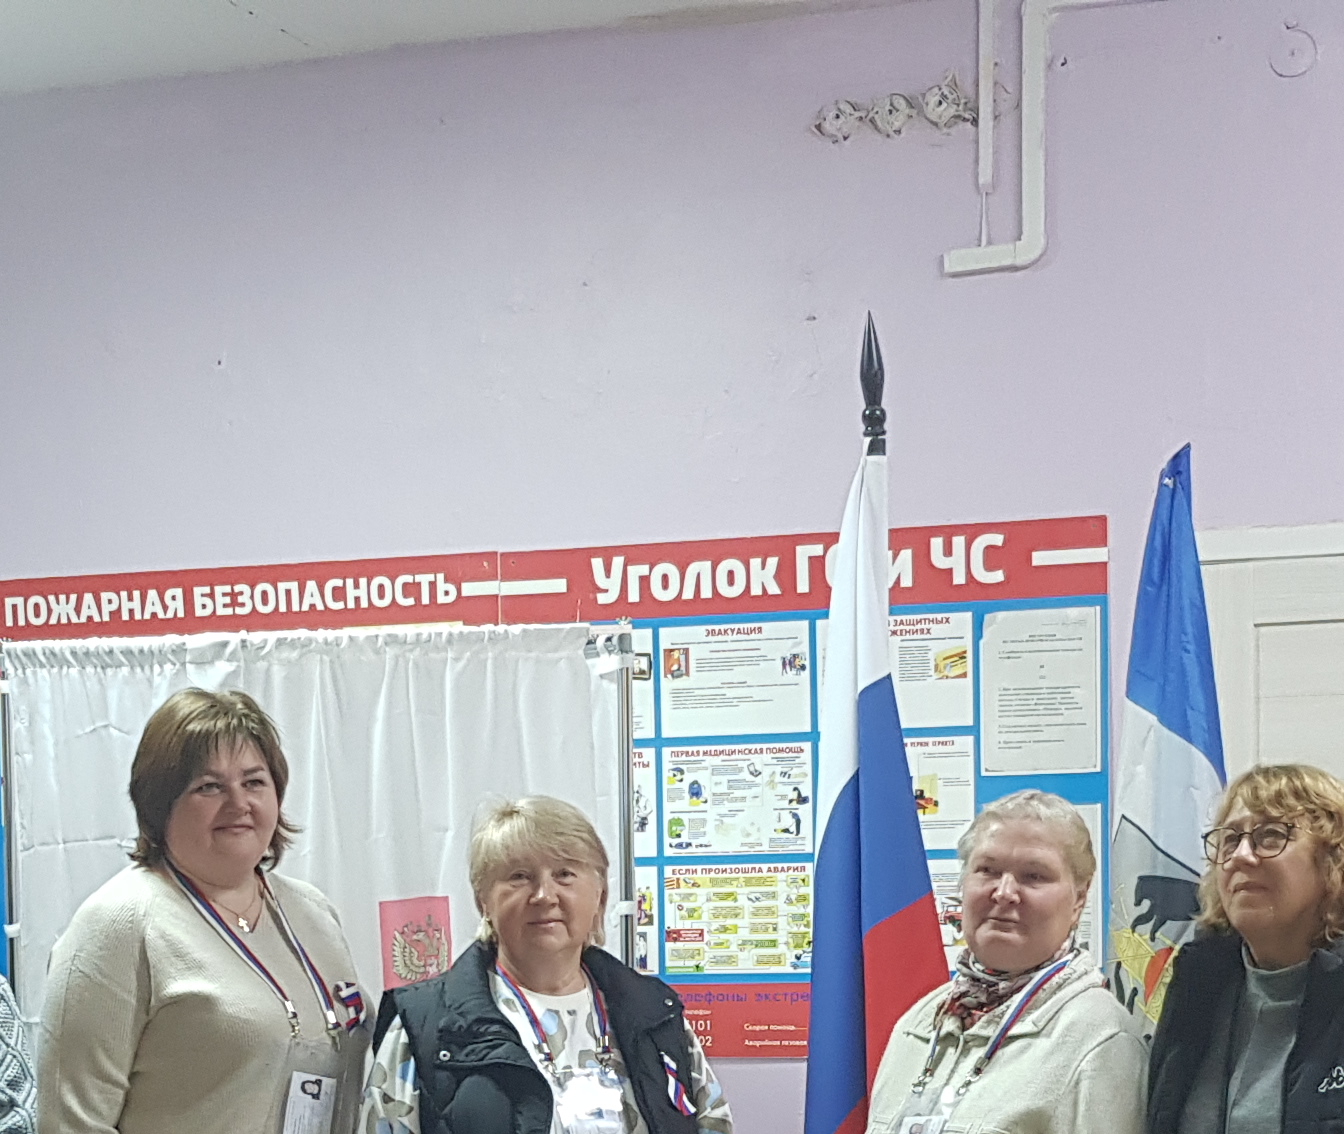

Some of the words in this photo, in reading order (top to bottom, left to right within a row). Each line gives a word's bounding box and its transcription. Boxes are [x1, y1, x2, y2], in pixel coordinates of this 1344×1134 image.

[590, 555, 781, 605] Уголок
[930, 533, 1005, 586] ЧС
[4, 587, 184, 627] ПОЖАРНАЯ
[192, 572, 457, 618] БЕЗОПАСНОСТЬ
[892, 616, 951, 628] ЗАЩИТНЫХ
[704, 626, 763, 638] ЭВАКУАЦИЯ
[889, 627, 932, 638] ЖЕНИЯХ
[670, 749, 701, 759] ПЕРВАЯ
[765, 745, 805, 755] ПОМОЩЬ
[671, 867, 698, 876] ЕСЛИ
[700, 866, 764, 876] ПРОИЗОШЛА
[766, 865, 807, 874] АВАРИЯ
[677, 991, 747, 1004] елефоны
[754, 991, 810, 1005] экстре
[691, 1019, 711, 1031] 101
[698, 1035, 713, 1046] 02
